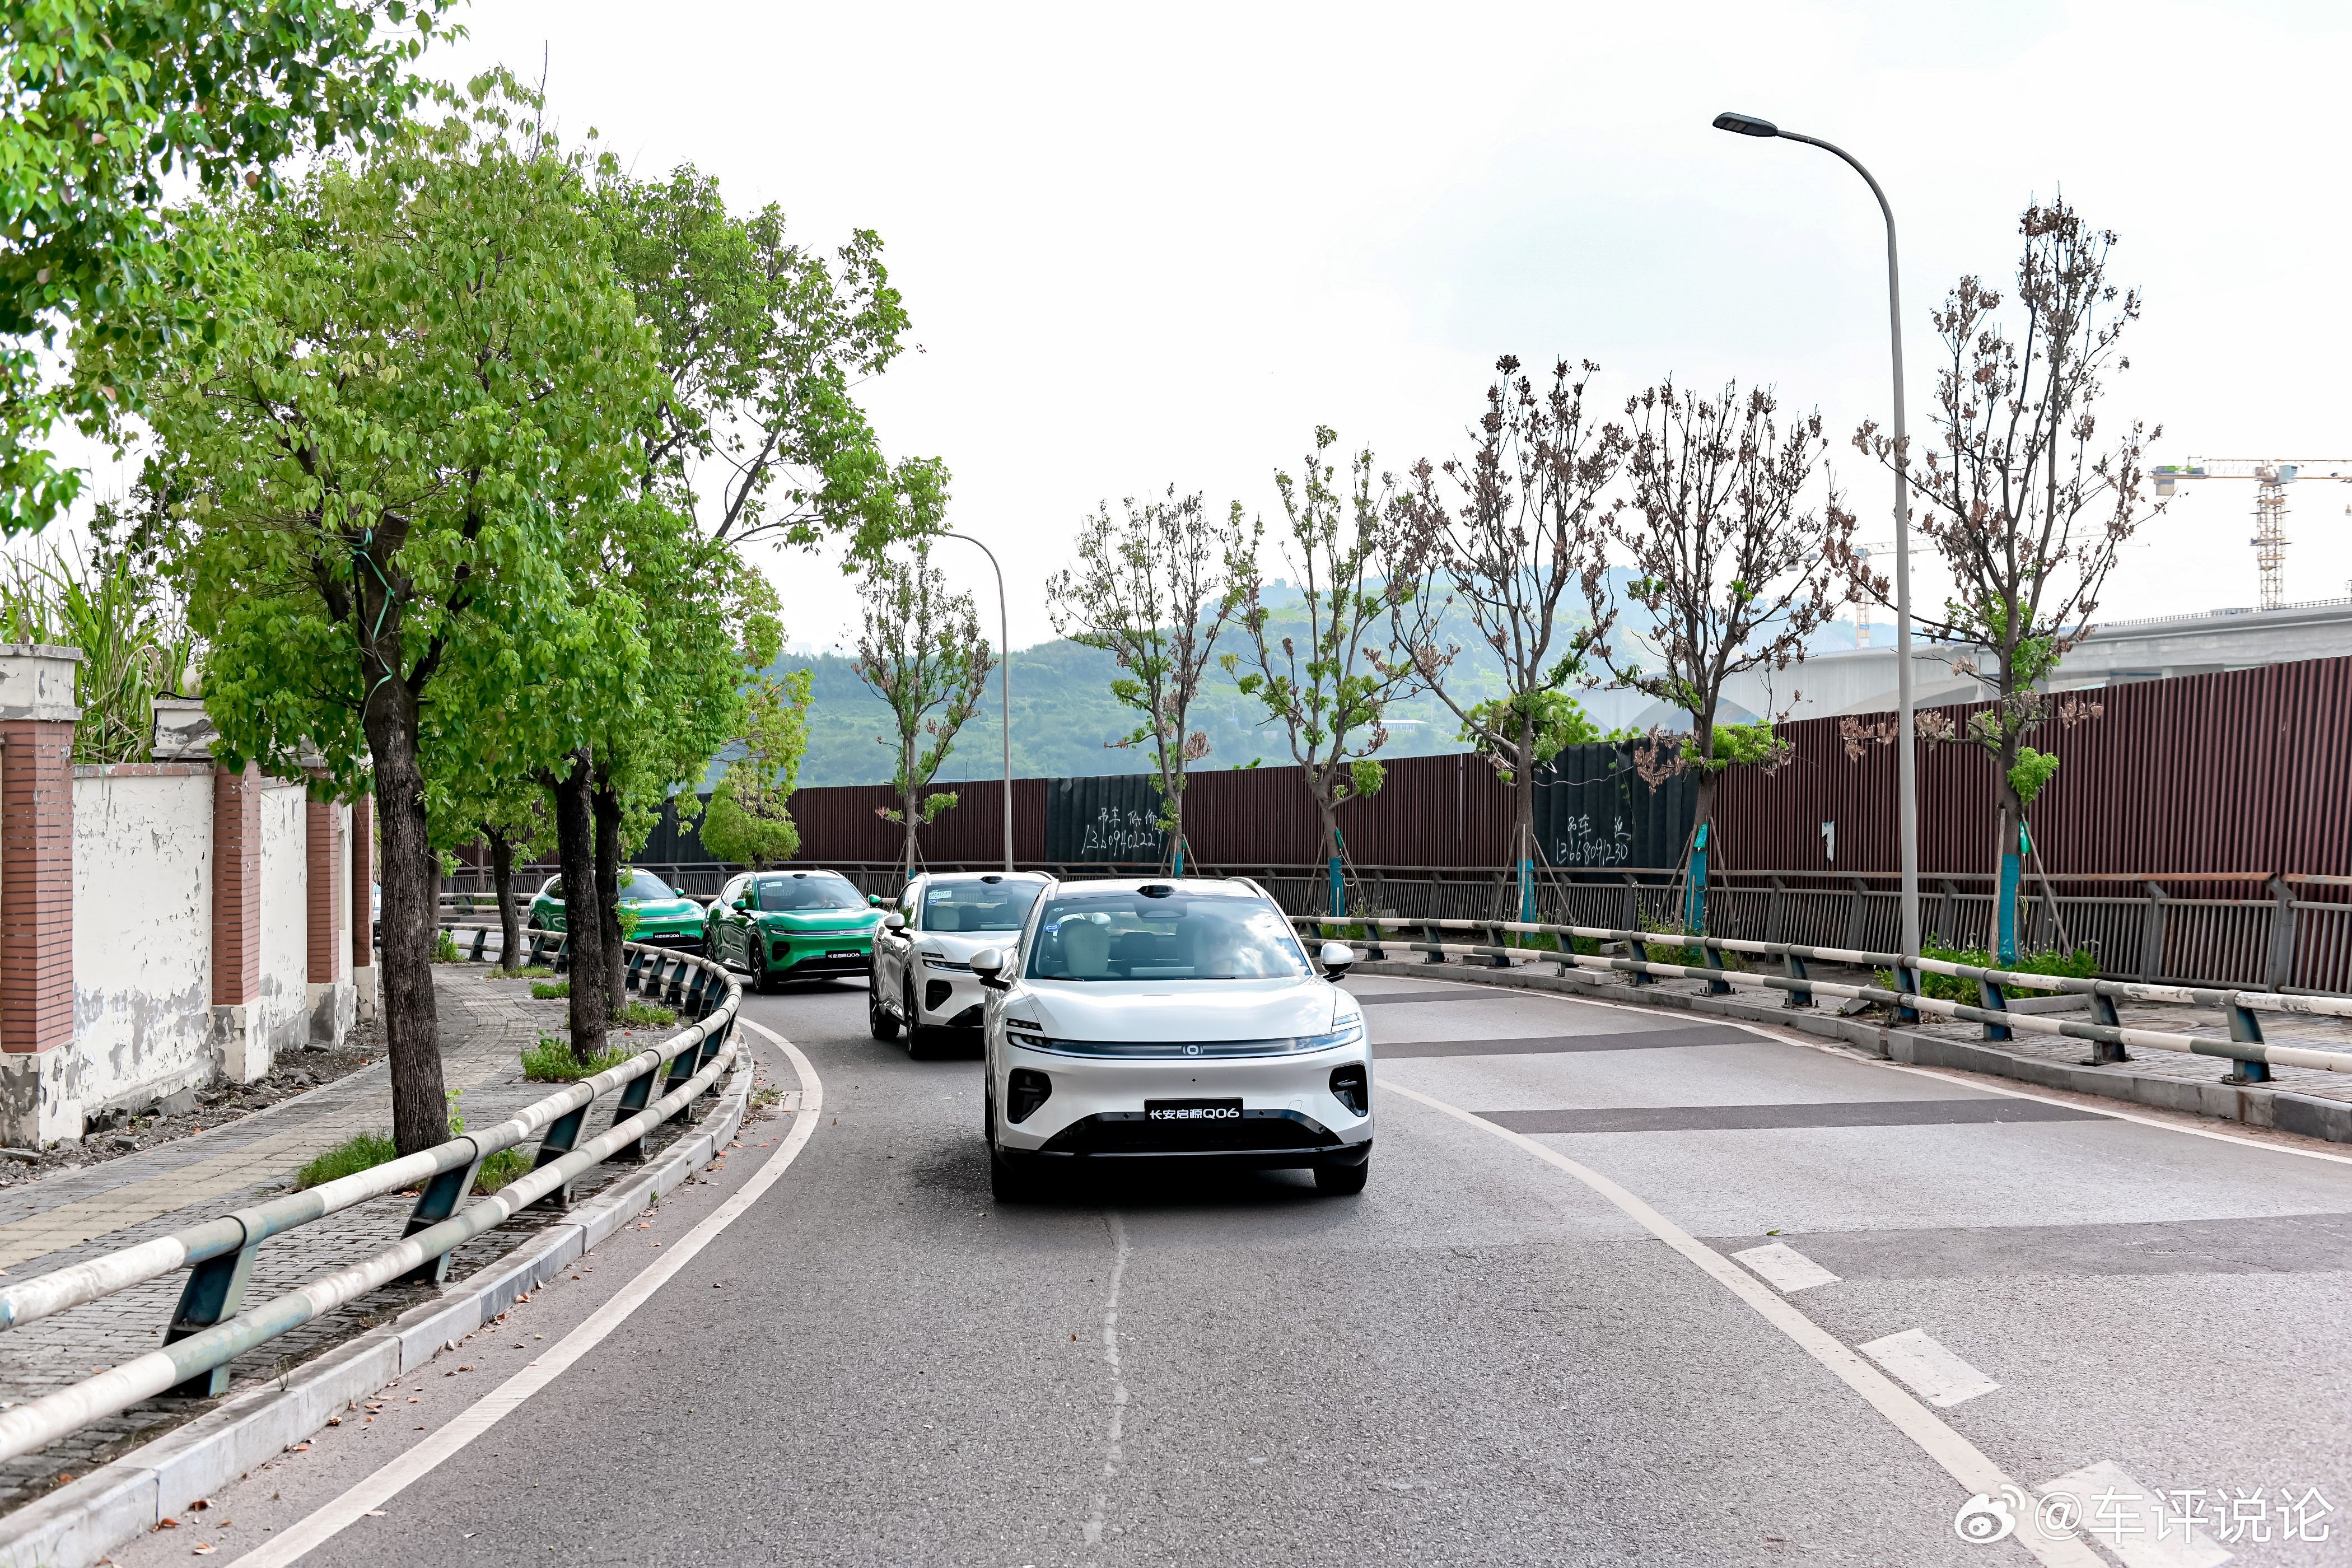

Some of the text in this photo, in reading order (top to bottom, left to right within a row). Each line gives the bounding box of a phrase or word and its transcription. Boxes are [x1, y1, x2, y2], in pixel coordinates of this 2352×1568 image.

[1556, 838, 1628, 867] 13668091230
[1150, 1108, 1239, 1119] 长安启源Q06
